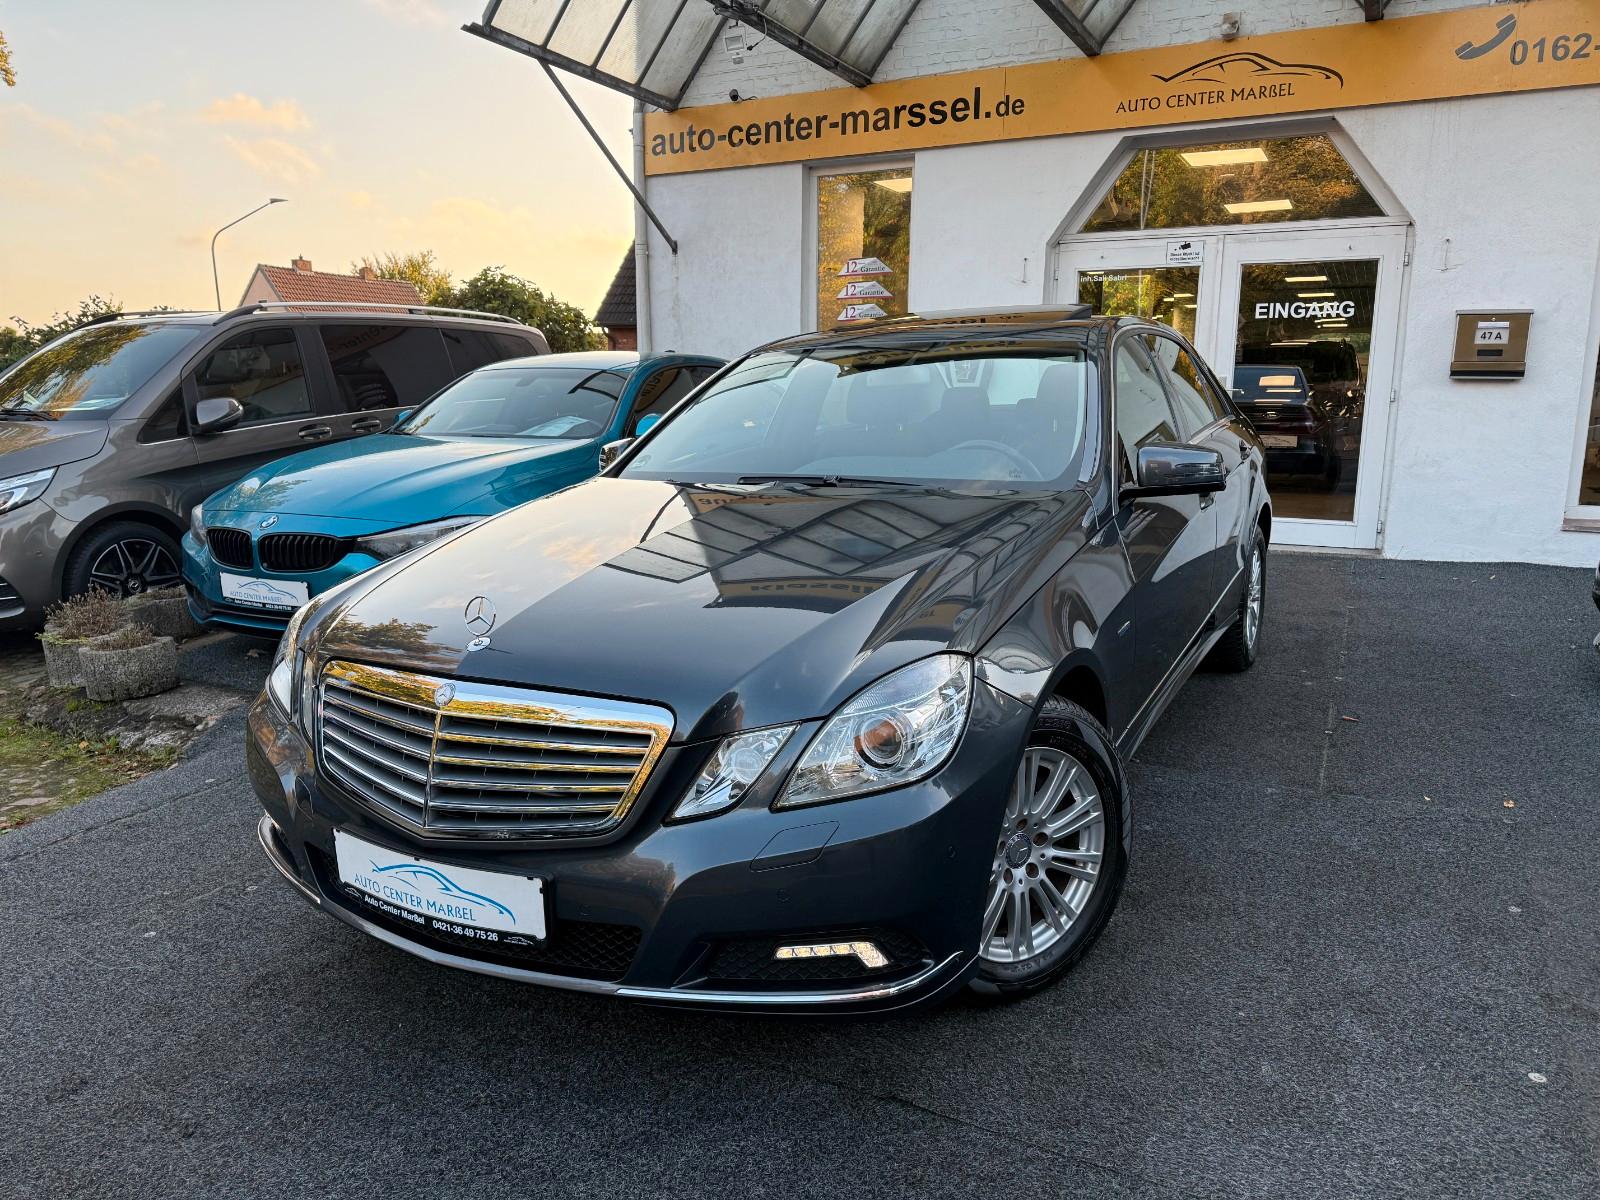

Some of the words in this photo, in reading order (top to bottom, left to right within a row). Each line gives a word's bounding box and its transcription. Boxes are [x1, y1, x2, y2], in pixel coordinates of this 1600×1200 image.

[1115, 96, 1162, 114] AUTO
[1166, 90, 1225, 109] CENTER
[651, 86, 1025, 157] auto-center-marssel.de
[845, 261, 858, 274] 12
[844, 284, 857, 297] 12
[844, 306, 856, 319] 12
[1254, 300, 1356, 320] EINGANG
[1480, 331, 1493, 340] 47
[1494, 331, 1502, 340] A
[354, 873, 381, 893] AUTO
[383, 885, 423, 910] CENTER
[364, 894, 379, 908] Auto
[378, 899, 401, 916] Center
[432, 920, 463, 935] 0421-36
[463, 928, 475, 938] 49
[475, 930, 487, 940] 75
[487, 932, 499, 942] 26
